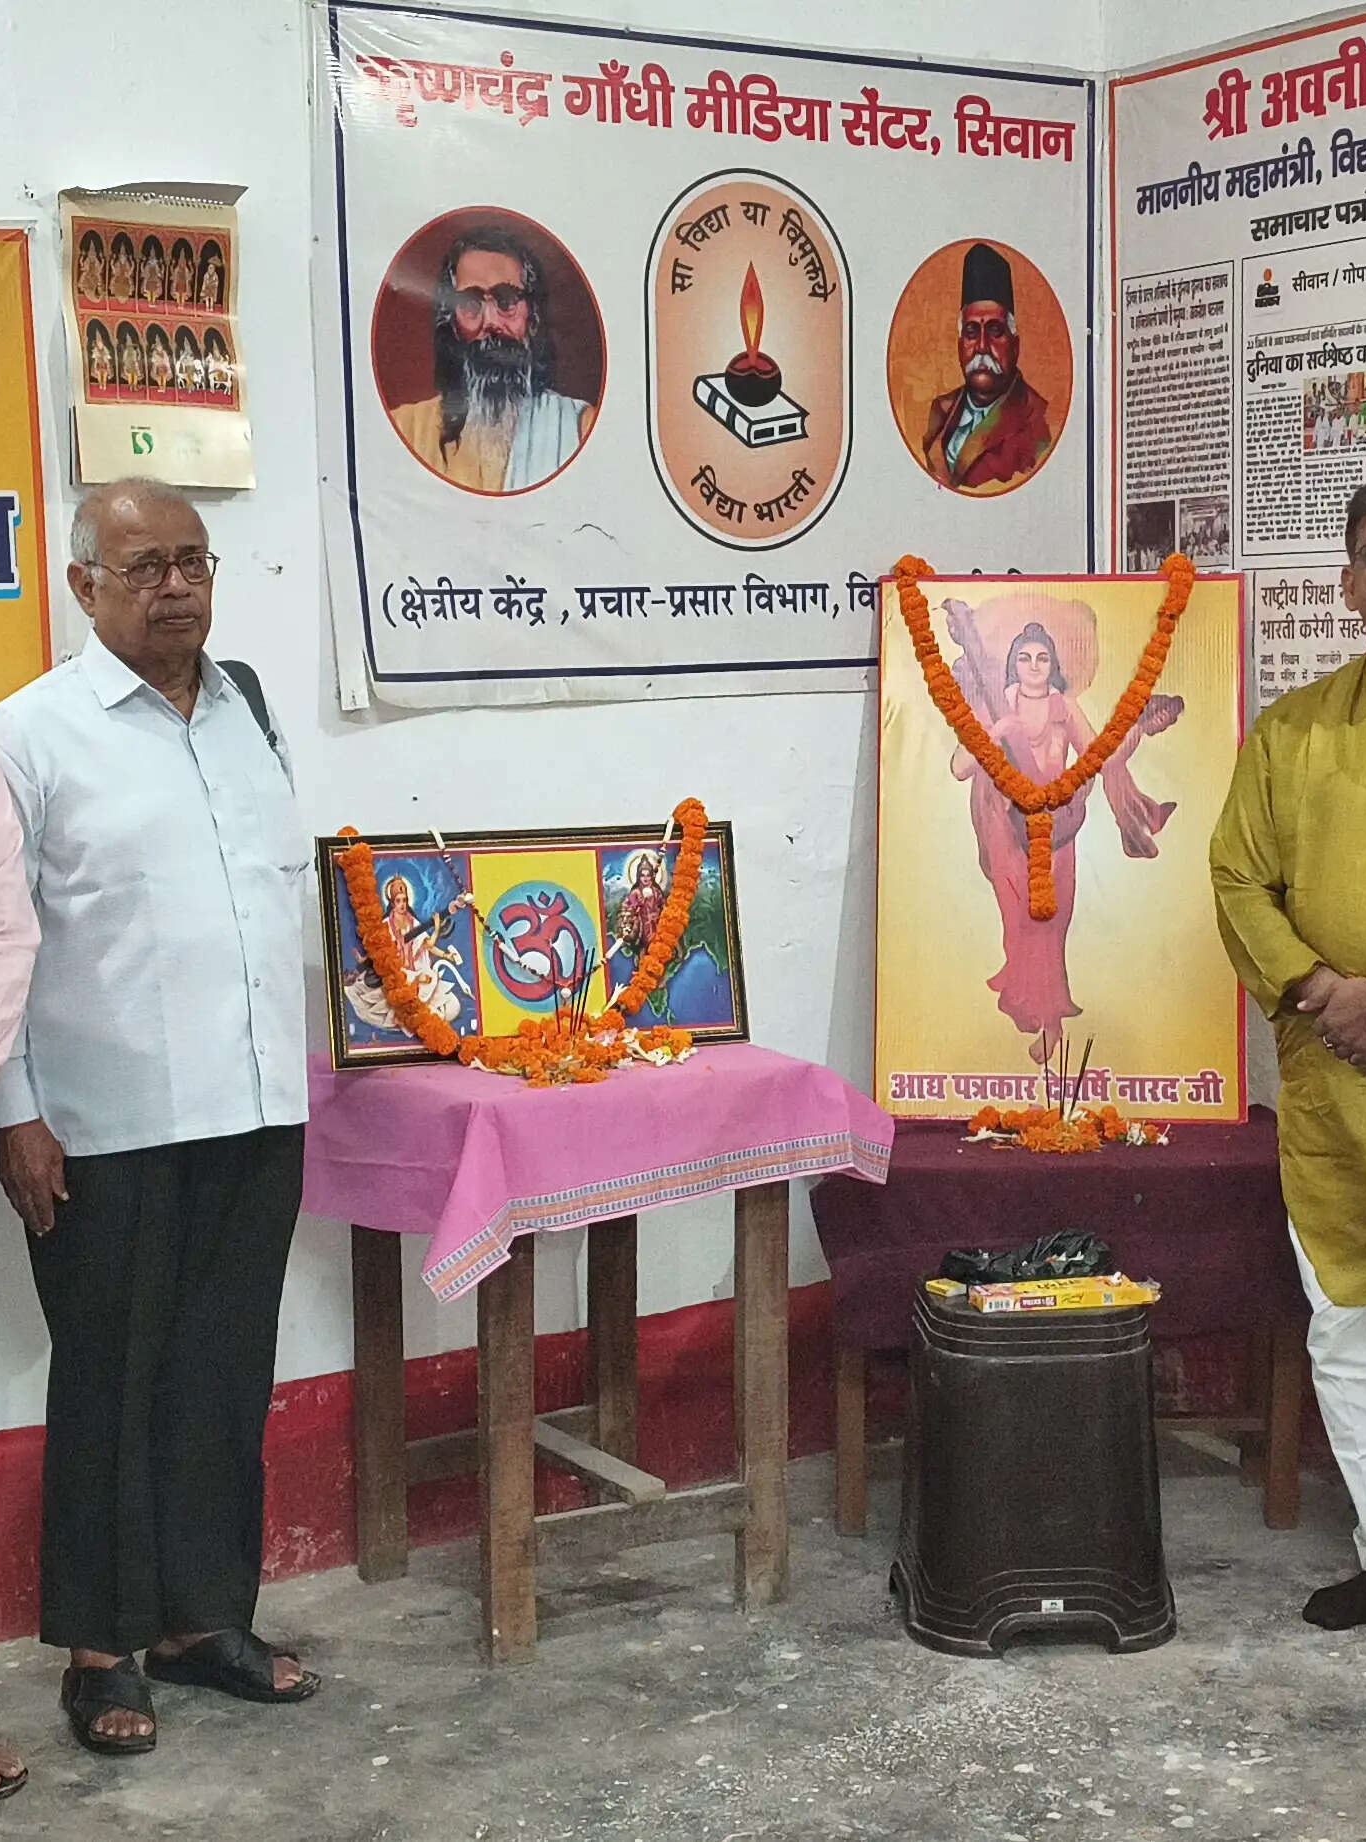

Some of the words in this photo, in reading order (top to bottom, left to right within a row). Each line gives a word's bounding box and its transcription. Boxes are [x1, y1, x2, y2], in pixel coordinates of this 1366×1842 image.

[563, 58, 675, 128] गाँधी
[684, 69, 832, 142] मीडिया
[840, 86, 940, 155] सेंटर,
[953, 95, 1076, 162] सिवान
[1202, 69, 1251, 140] श्री
[1136, 161, 1220, 216] माननीय
[1226, 136, 1323, 197] महामंत्री,
[675, 204, 731, 251] विद्या
[740, 201, 770, 226] या
[1250, 203, 1332, 243] समाचार
[671, 257, 694, 295] सा
[1292, 270, 1330, 293] सीवान
[1247, 350, 1283, 382] दुनिया
[1285, 352, 1304, 372] का
[1306, 342, 1354, 369] सर्वश्रेष्ठ
[1355, 345, 1366, 364] व
[690, 464, 747, 524] विद्या
[753, 467, 817, 523] भारती
[490, 574, 547, 626] केंद्र
[574, 584, 736, 621] प्रचार-प्रसार
[742, 572, 839, 619] विभाग,
[1261, 578, 1298, 610] राष्ट्रीय
[1302, 578, 1335, 607] शिक्षा
[1260, 612, 1295, 640] भारती
[1299, 611, 1334, 640] करेगी
[951, 1074, 1039, 1101] पत्रकार
[1116, 1076, 1181, 1102] नारद
[1184, 1070, 1224, 1103] जी
